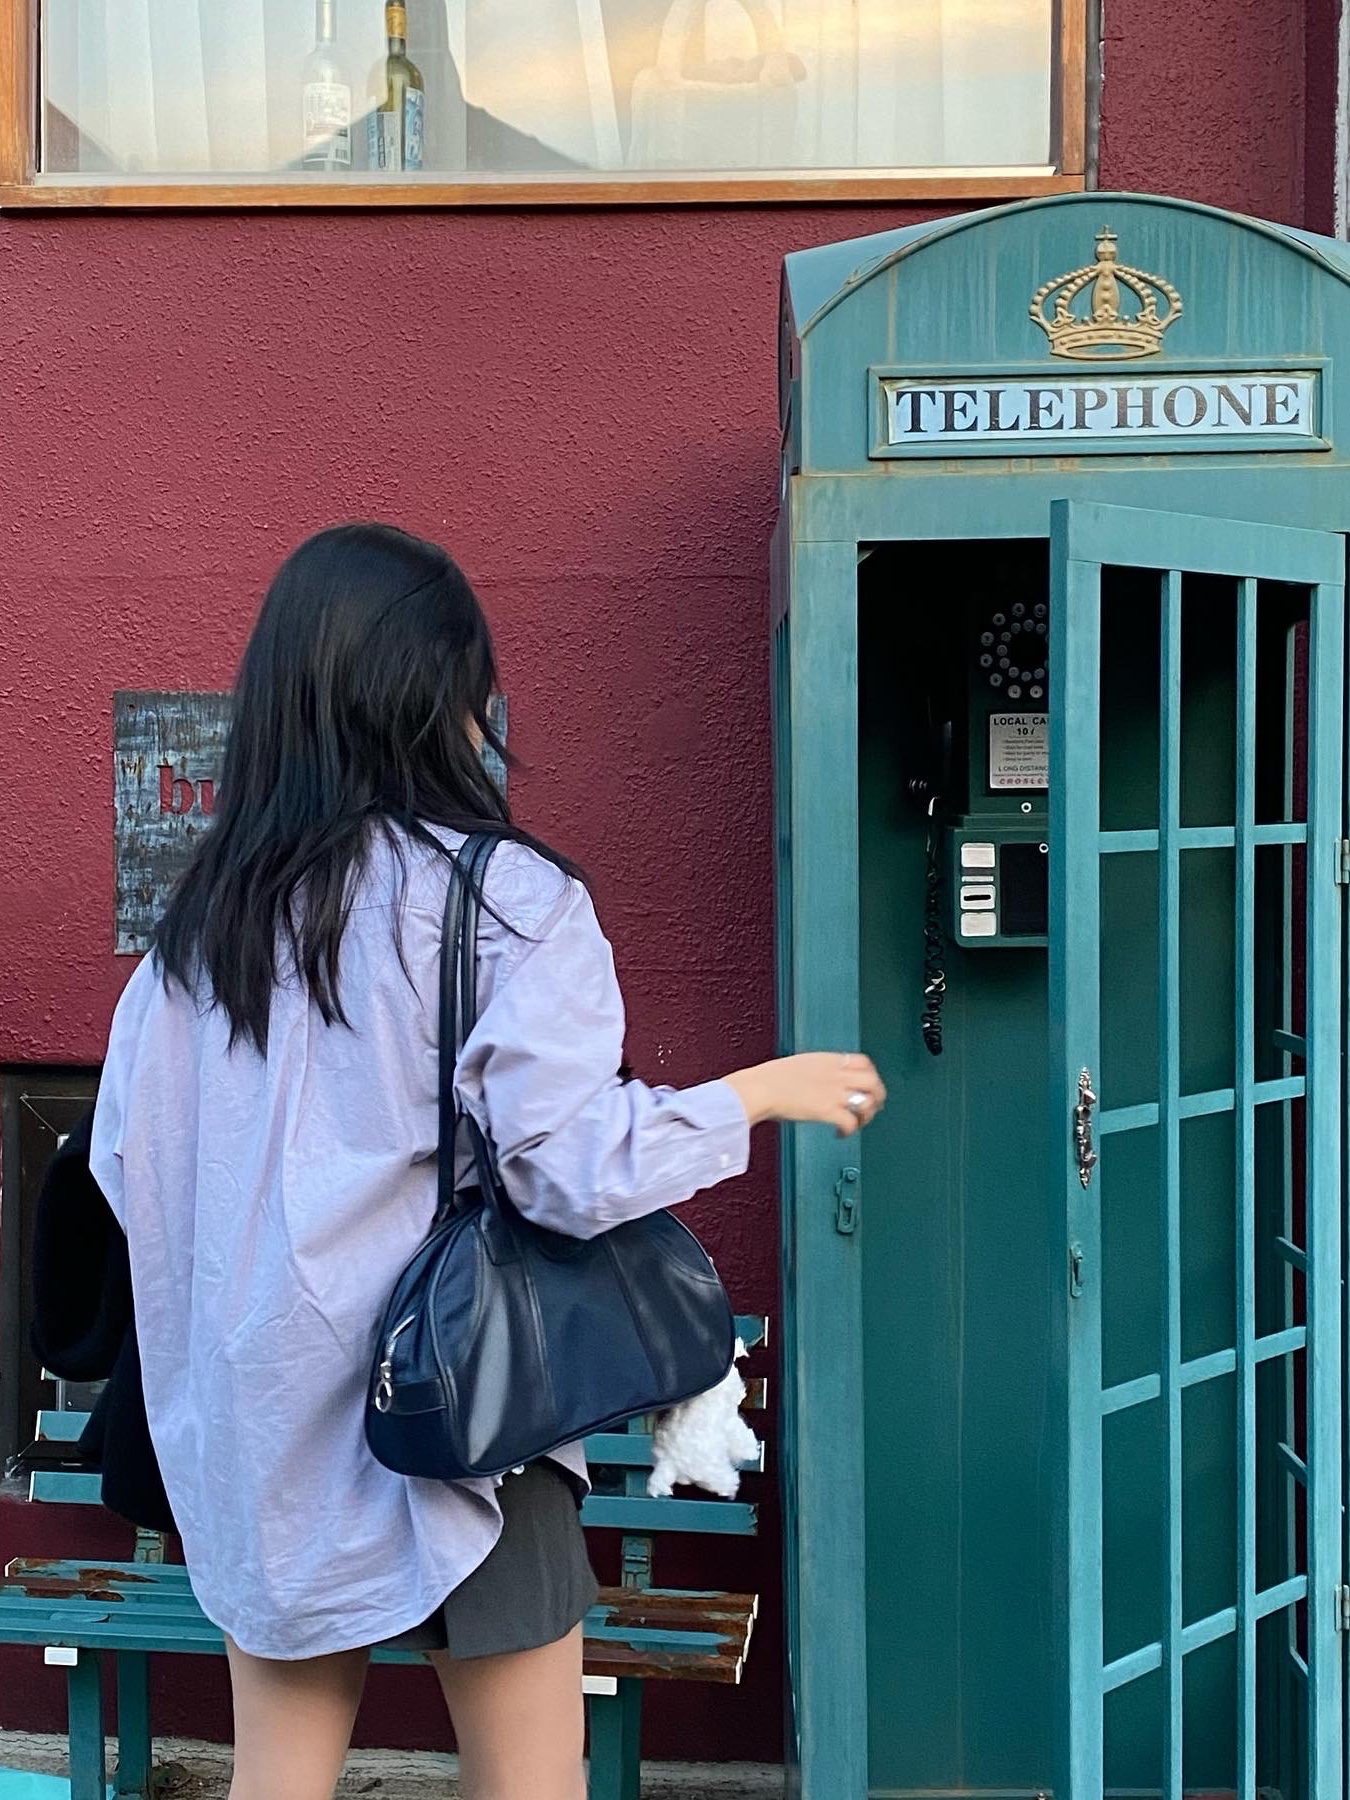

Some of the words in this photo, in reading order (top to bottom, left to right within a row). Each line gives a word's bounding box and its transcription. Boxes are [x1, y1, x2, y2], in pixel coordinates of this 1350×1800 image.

[896, 382, 1300, 433] TELEPHONE
[993, 717, 1027, 726] LOCAL
[1032, 717, 1049, 725] CA
